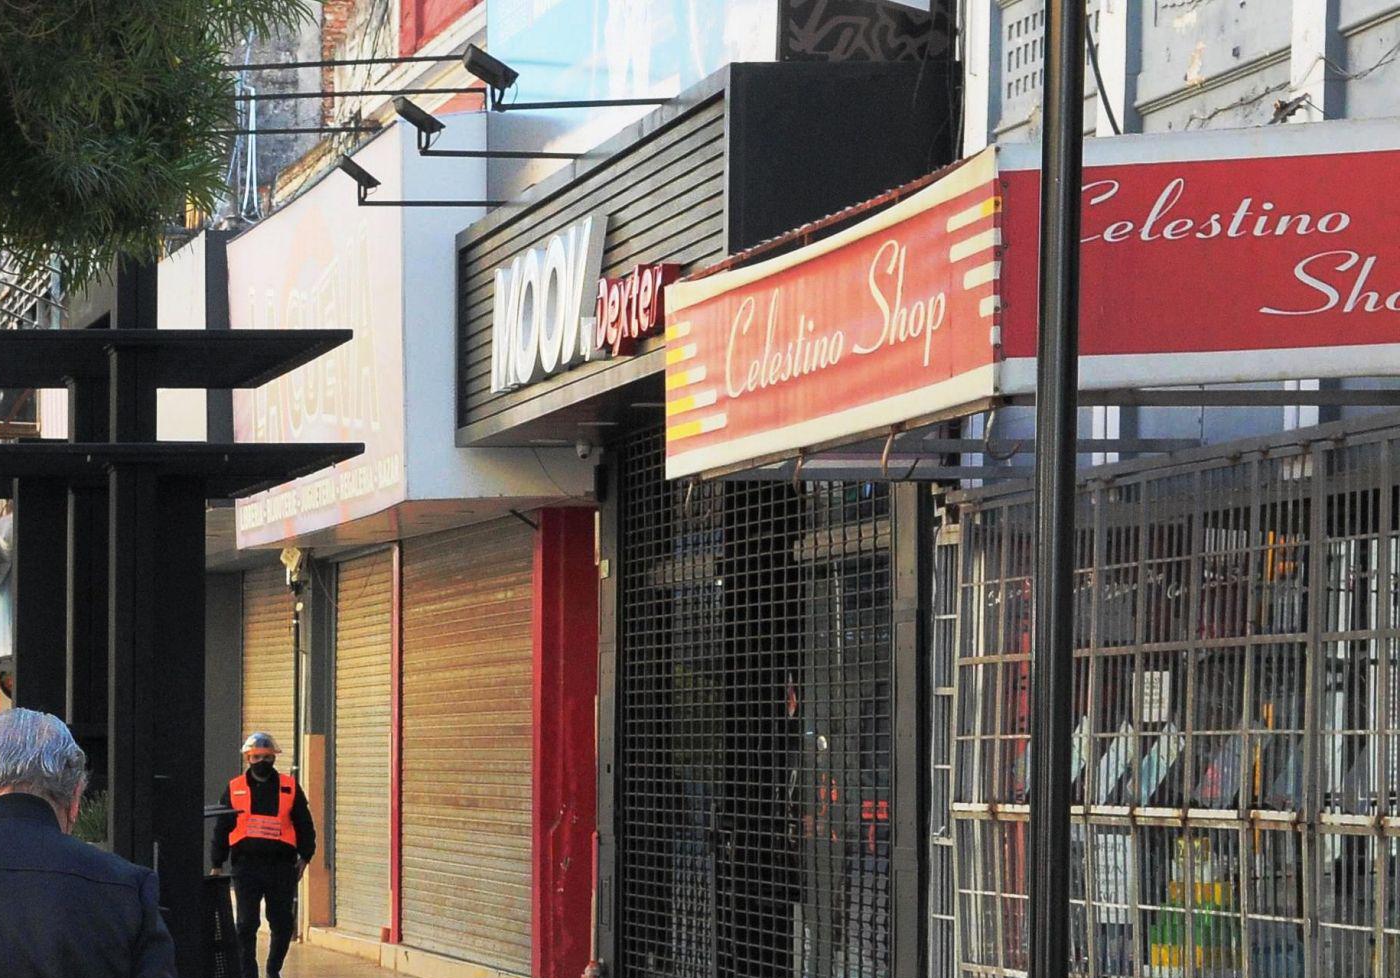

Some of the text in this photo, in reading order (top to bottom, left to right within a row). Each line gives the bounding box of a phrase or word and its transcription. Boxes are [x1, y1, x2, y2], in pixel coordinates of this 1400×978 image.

[491, 216, 593, 393] MOOV
[596, 263, 662, 357] Dexter
[725, 240, 946, 398] Celestino Shop
